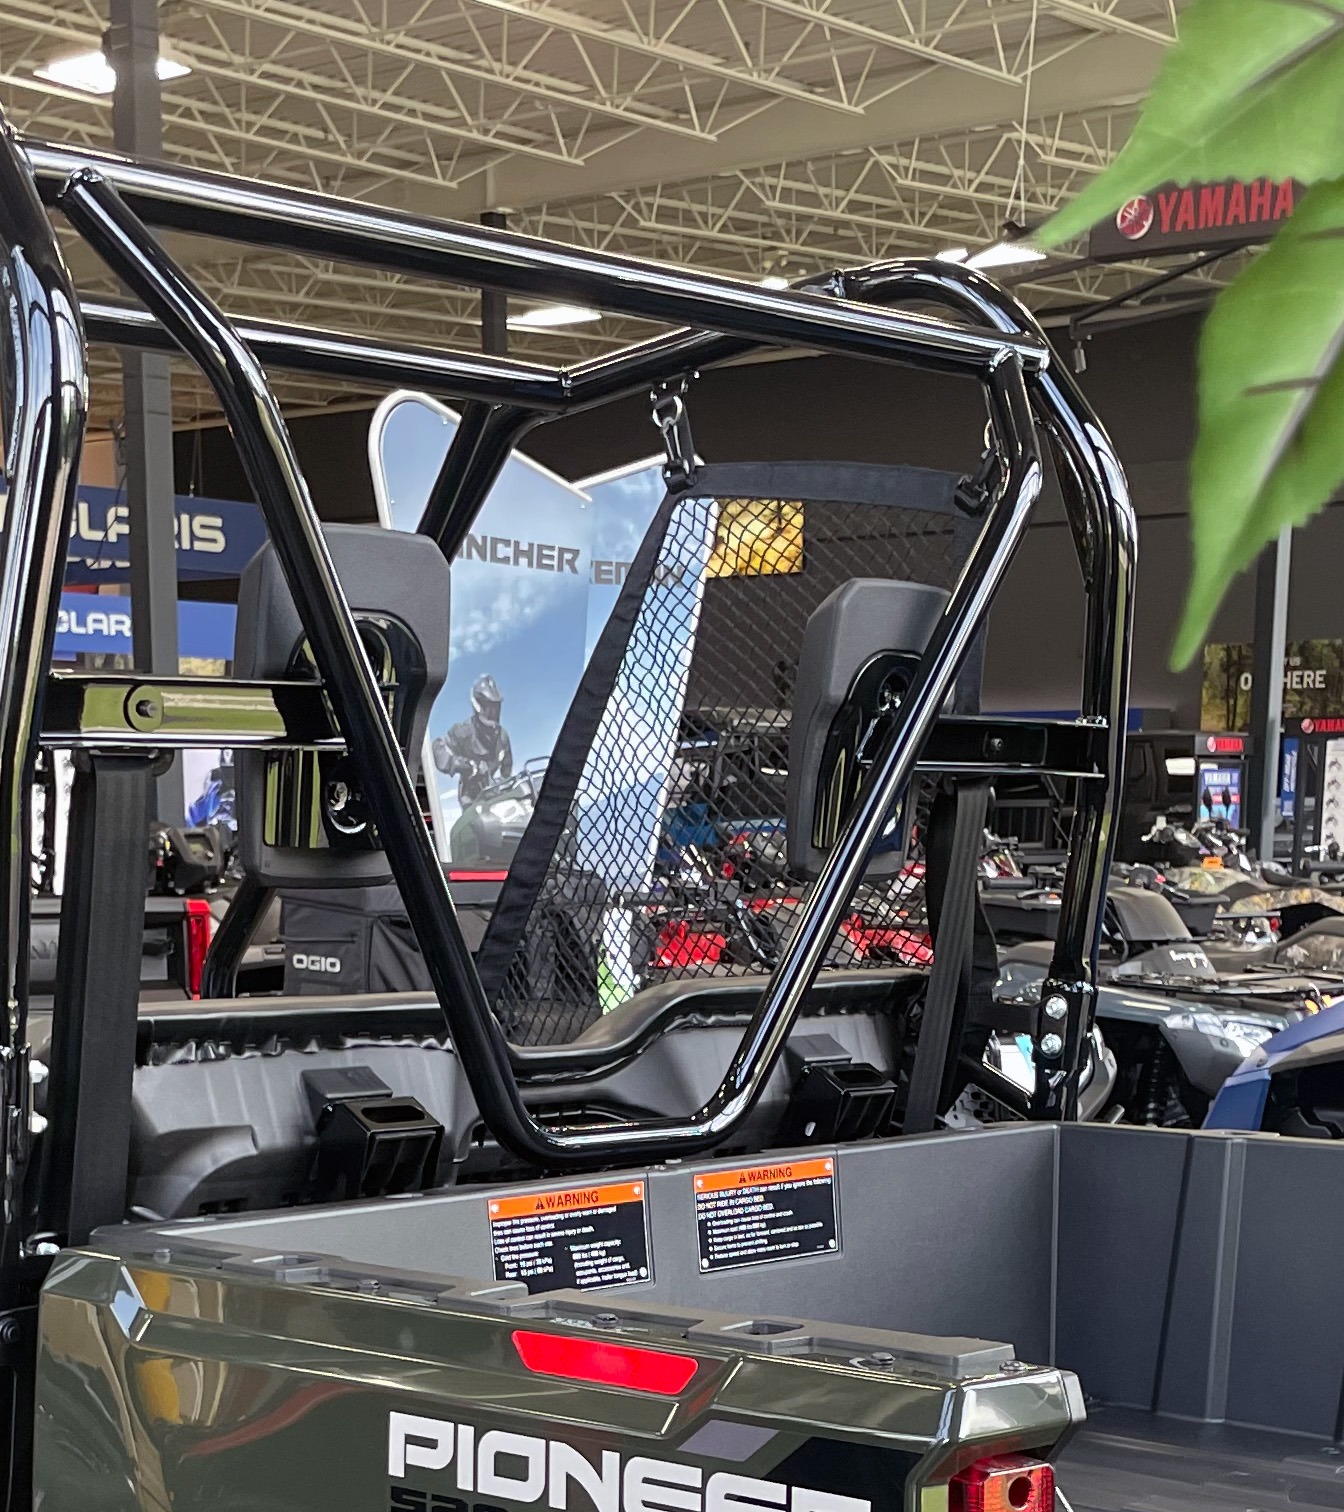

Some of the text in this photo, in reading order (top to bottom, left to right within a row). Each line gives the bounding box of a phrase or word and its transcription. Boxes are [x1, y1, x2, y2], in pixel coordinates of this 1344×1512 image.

[1158, 176, 1294, 234] YAMAHA
[457, 533, 580, 575] NCHER
[55, 610, 132, 637] OLAR
[1283, 670, 1327, 689] HERE
[293, 954, 340, 973] OGIO
[748, 1166, 793, 1182] WARNING
[546, 1190, 599, 1208] WARNING
